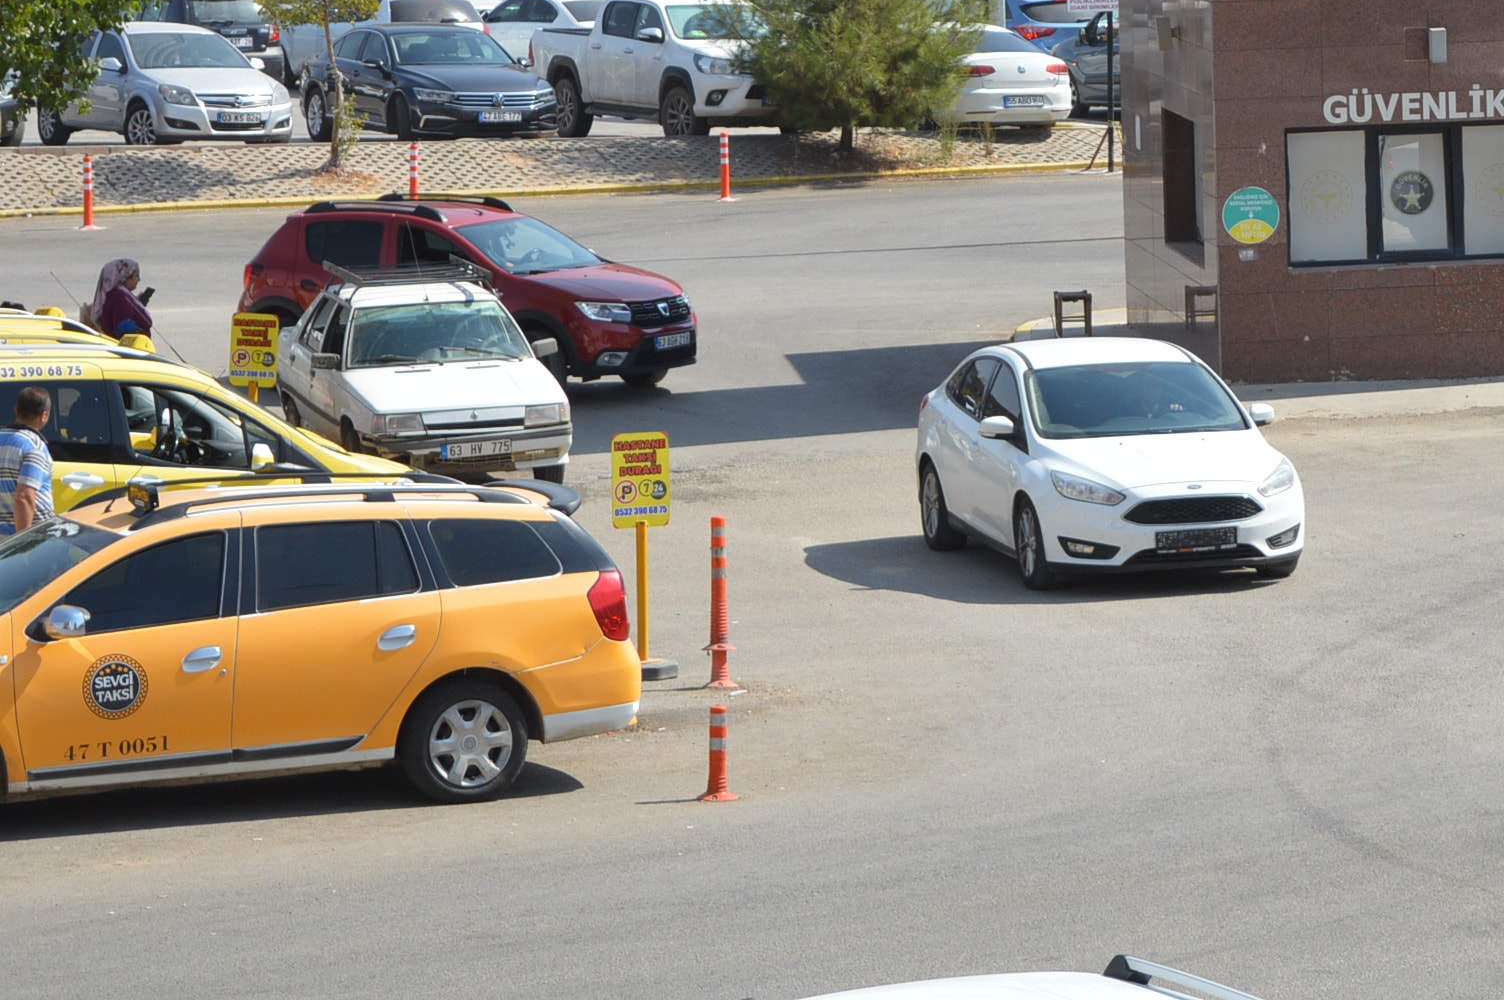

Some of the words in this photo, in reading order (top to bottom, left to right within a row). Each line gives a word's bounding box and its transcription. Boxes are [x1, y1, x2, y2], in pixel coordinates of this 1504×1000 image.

[20, 366, 43, 377] 390
[47, 366, 63, 377] 68
[66, 365, 82, 376] 75
[449, 445, 462, 457] 63
[470, 443, 483, 455] HV
[491, 440, 510, 453] 775
[614, 439, 666, 451] HASTANE
[623, 449, 657, 463] TAKSİ
[619, 463, 662, 476] DURAĞI
[614, 508, 633, 517] 0532
[659, 505, 668, 514] 75
[94, 670, 134, 689] SEVGİ
[95, 685, 134, 703] TAKSİ
[63, 744, 90, 762] 47
[97, 741, 112, 757] T
[119, 735, 169, 756] 0051
